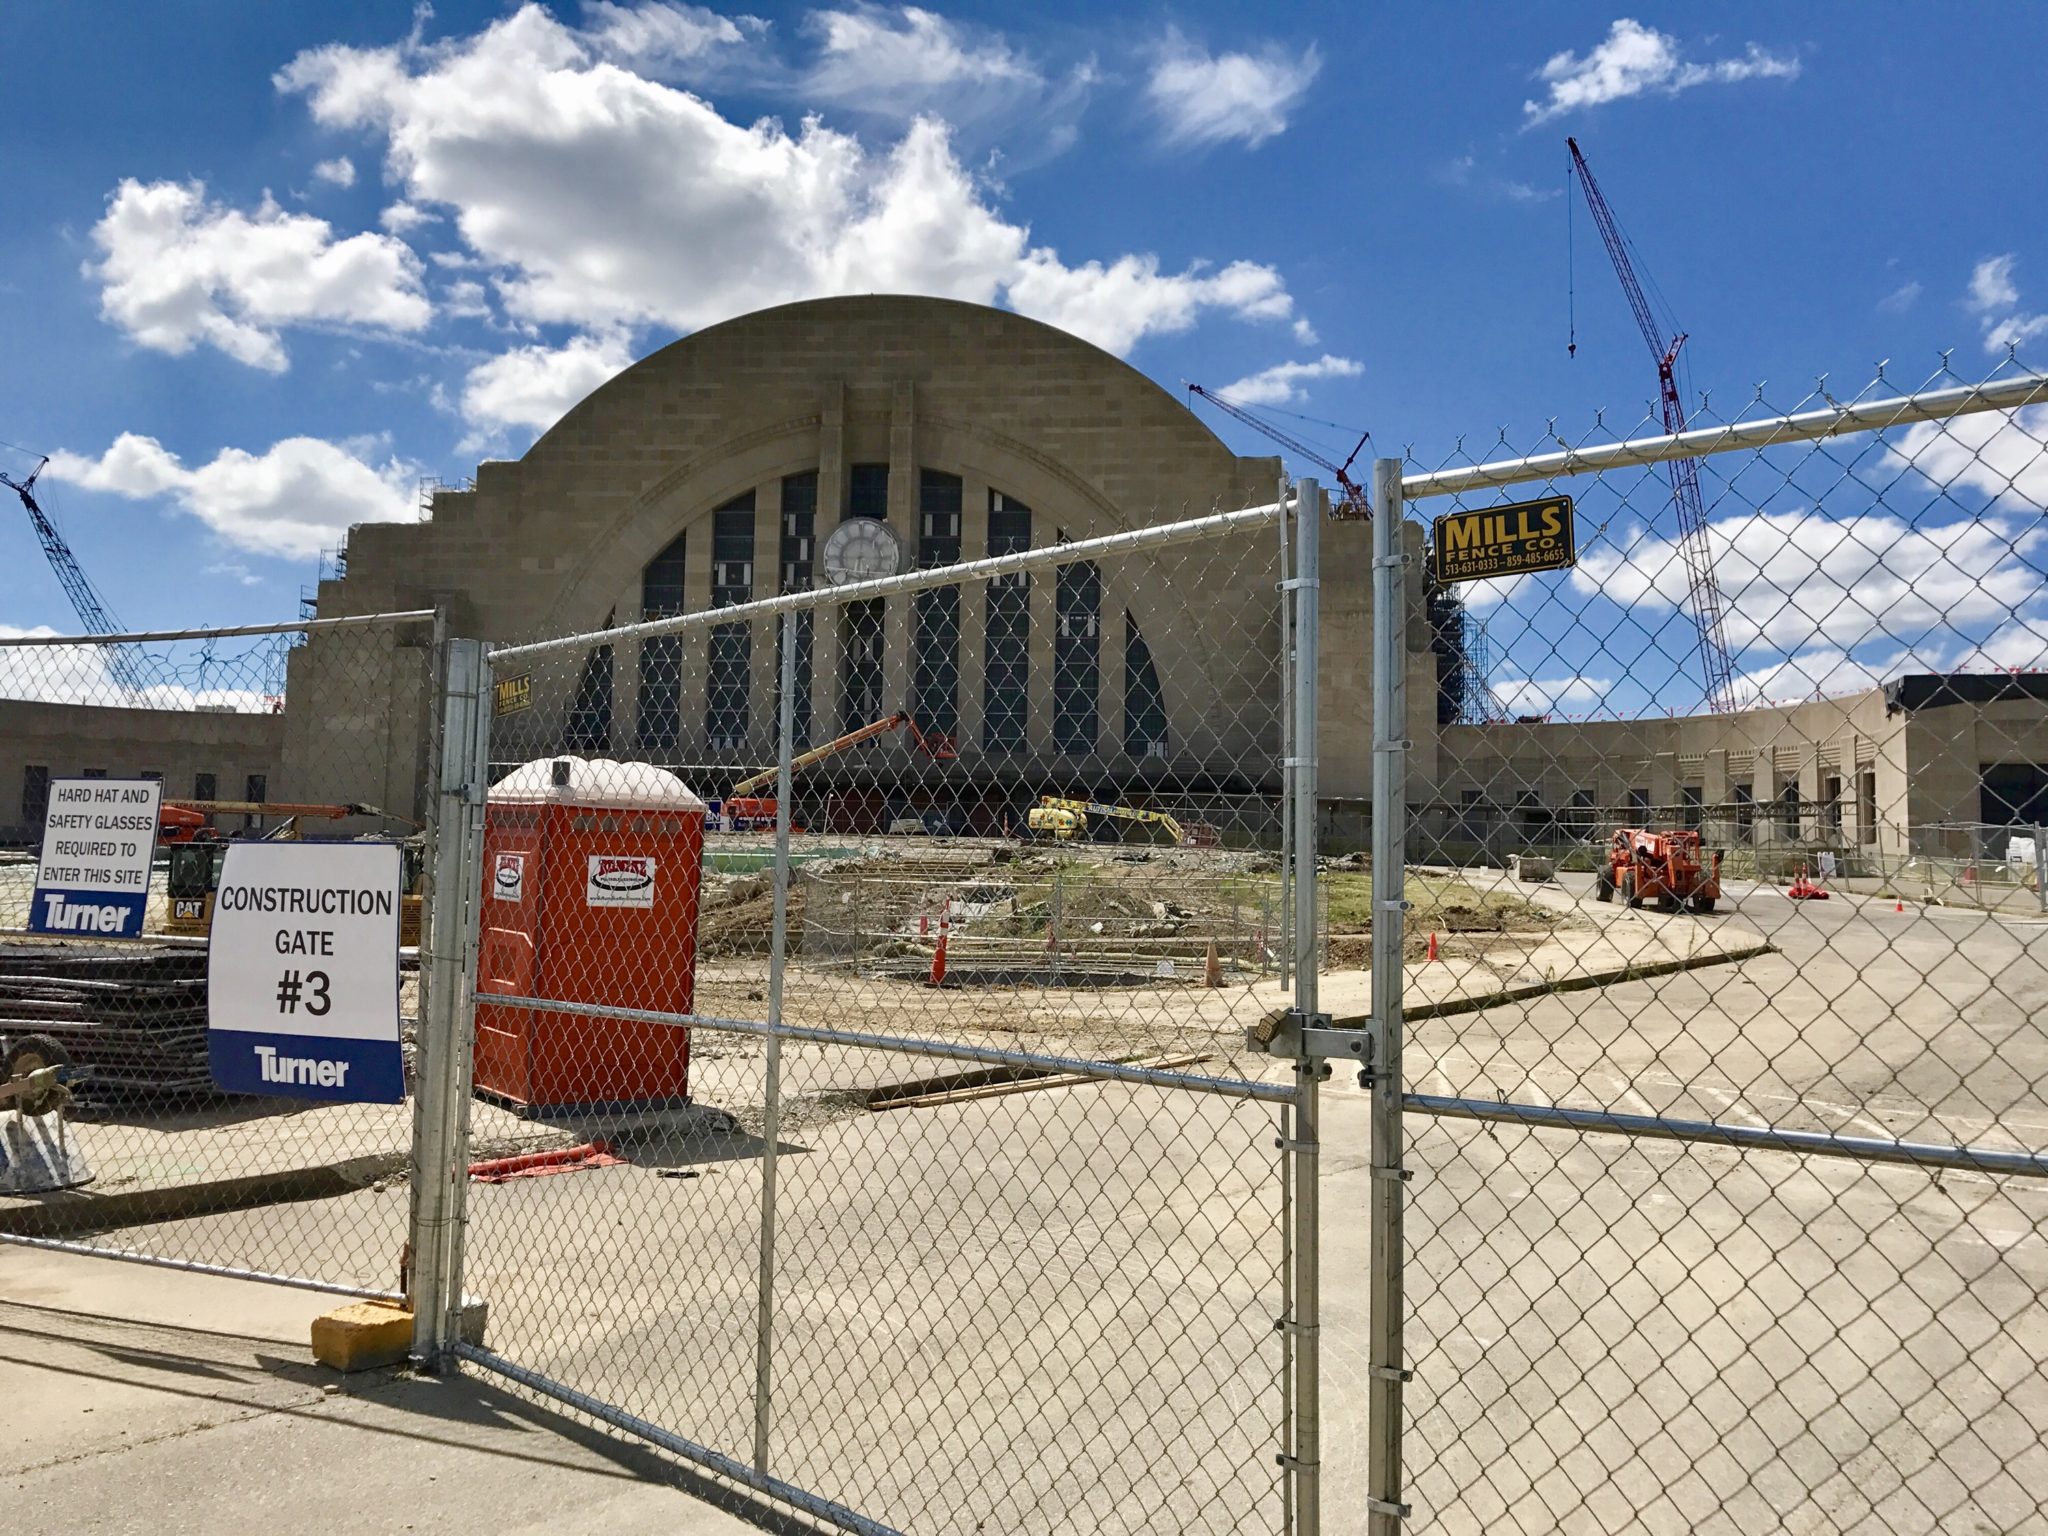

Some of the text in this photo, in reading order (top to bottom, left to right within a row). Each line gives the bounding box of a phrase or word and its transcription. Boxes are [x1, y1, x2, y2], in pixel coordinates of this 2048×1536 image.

[1446, 506, 1561, 551] MILLS
[1446, 538, 1563, 562] FENCE CO.
[1446, 558, 1498, 575] 513-631-0333
[1507, 549, 1564, 566] 859-485-6655
[500, 677, 529, 700] MILLS
[58, 789, 149, 803] HARD HAT AND
[49, 815, 152, 831] SAFETY GLASSES
[55, 842, 136, 858] REQUIRED TO
[44, 868, 142, 884] ENTER THIS SITE
[44, 894, 131, 933] Turner
[176, 901, 201, 918] CAT
[221, 887, 392, 916] CONSTRUCTION
[275, 930, 334, 956] GATE
[277, 969, 331, 1016] #3
[254, 1045, 349, 1087] Turner
